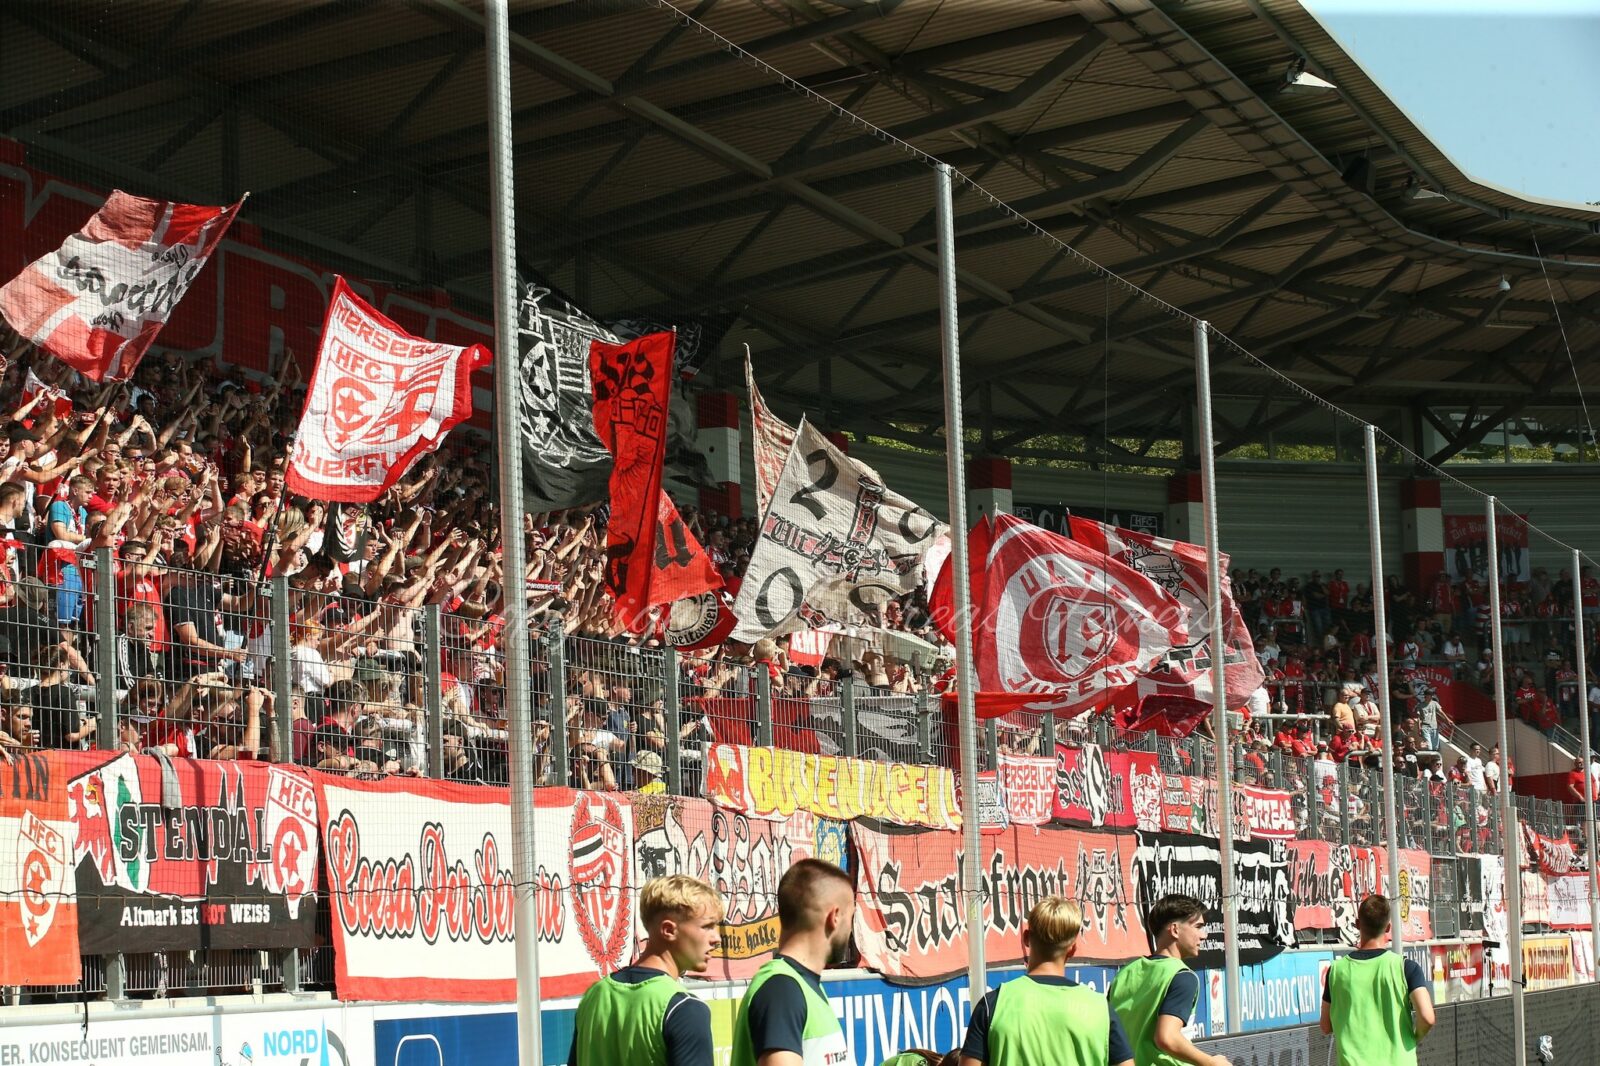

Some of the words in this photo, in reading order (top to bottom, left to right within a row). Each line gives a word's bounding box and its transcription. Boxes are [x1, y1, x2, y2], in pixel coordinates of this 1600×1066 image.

[335, 346, 382, 381] HFC
[279, 773, 315, 816] HFC
[28, 815, 57, 854] HFC
[118, 802, 273, 863] STENDAL
[120, 906, 178, 927] Altmark
[181, 905, 199, 925] ist
[202, 904, 227, 925] ROT
[230, 903, 271, 924] WEISS
[1241, 980, 1265, 1022] ADIO
[1267, 974, 1316, 1019] BROCKEN
[29, 1037, 126, 1064] KONSEQUENT
[129, 1032, 212, 1056] GEMEINSAM.
[263, 1029, 319, 1057] NORD
